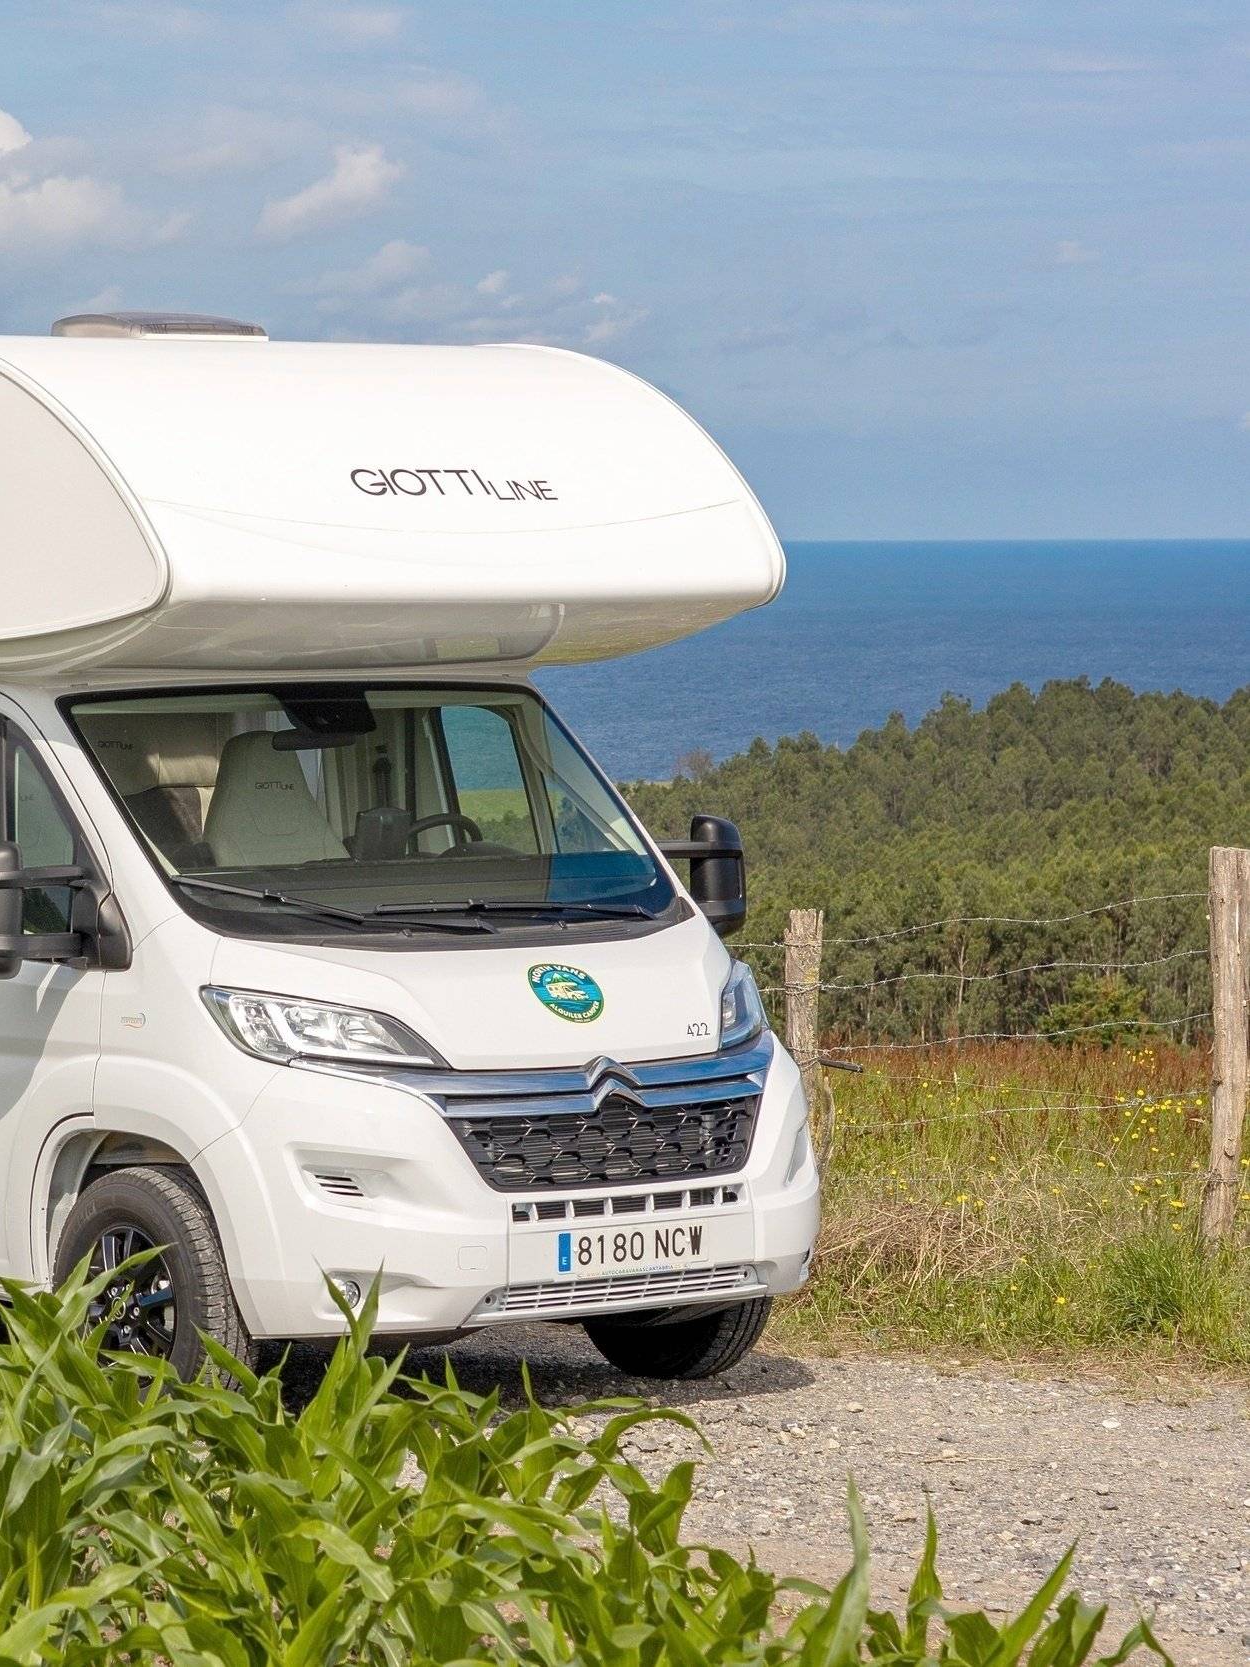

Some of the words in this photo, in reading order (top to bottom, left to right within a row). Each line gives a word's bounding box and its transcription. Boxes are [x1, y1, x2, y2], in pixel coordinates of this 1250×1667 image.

[531, 965, 553, 984] NORTH
[552, 965, 587, 980] VANS
[686, 1022, 711, 1037] 422
[577, 1230, 645, 1266] 8180
[655, 1225, 703, 1259] NCW
[561, 1256, 568, 1266] E
